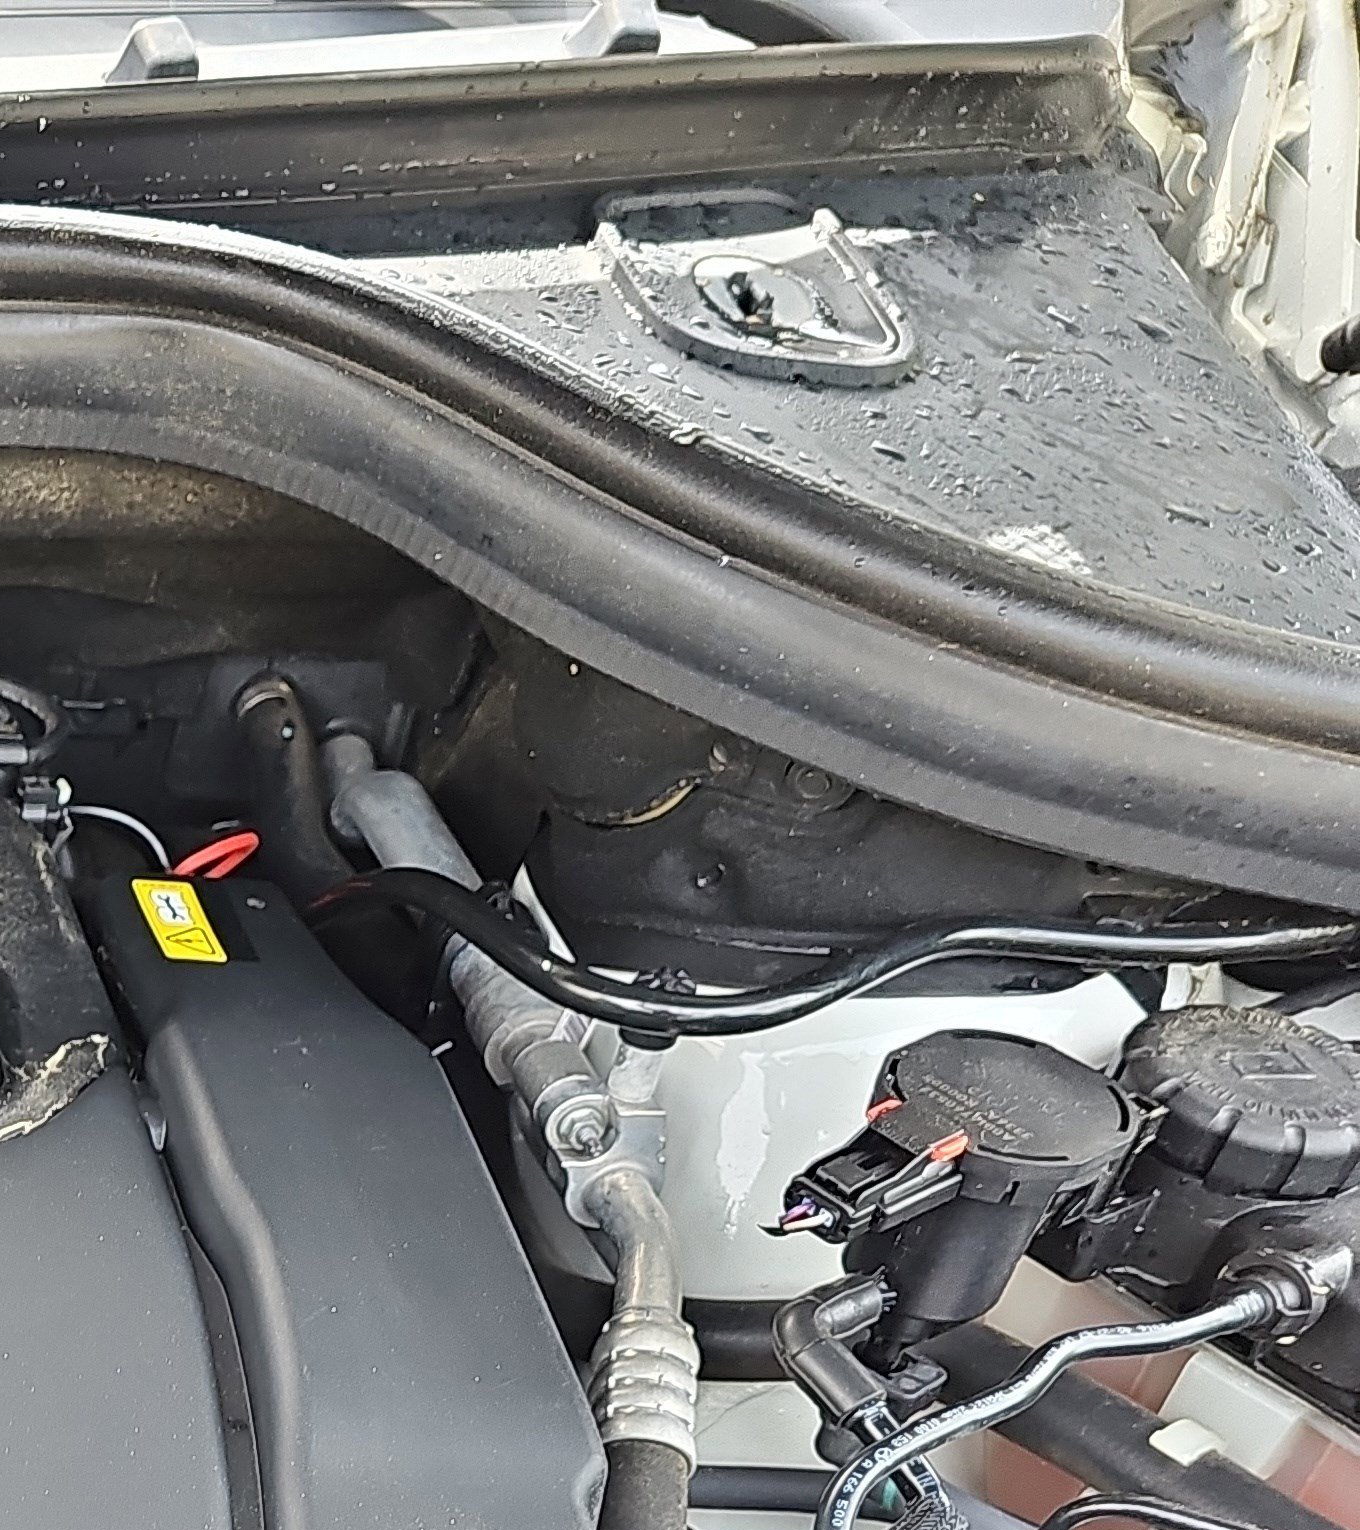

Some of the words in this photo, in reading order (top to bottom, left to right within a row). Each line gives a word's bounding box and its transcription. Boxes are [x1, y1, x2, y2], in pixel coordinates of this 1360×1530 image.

[862, 1458, 874, 1470] A
[843, 1472, 863, 1494] 166
[832, 1499, 849, 1527] 500
